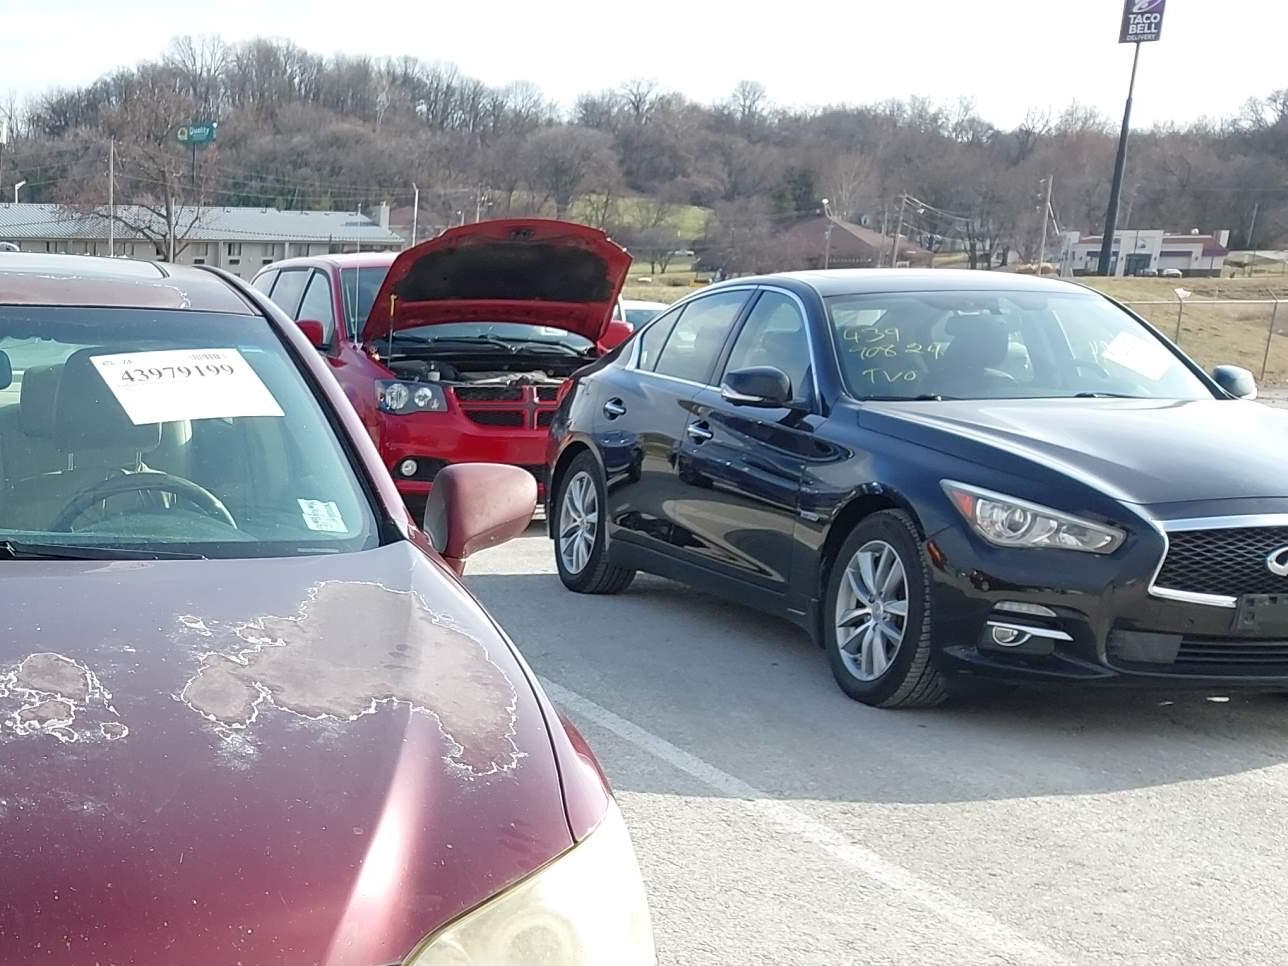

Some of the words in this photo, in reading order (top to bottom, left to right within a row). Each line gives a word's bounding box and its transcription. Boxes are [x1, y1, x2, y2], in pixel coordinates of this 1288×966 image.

[1128, 13, 1160, 24] TACO
[1128, 23, 1158, 34] BELL
[843, 328, 900, 343] 439
[121, 363, 235, 382] 43979199
